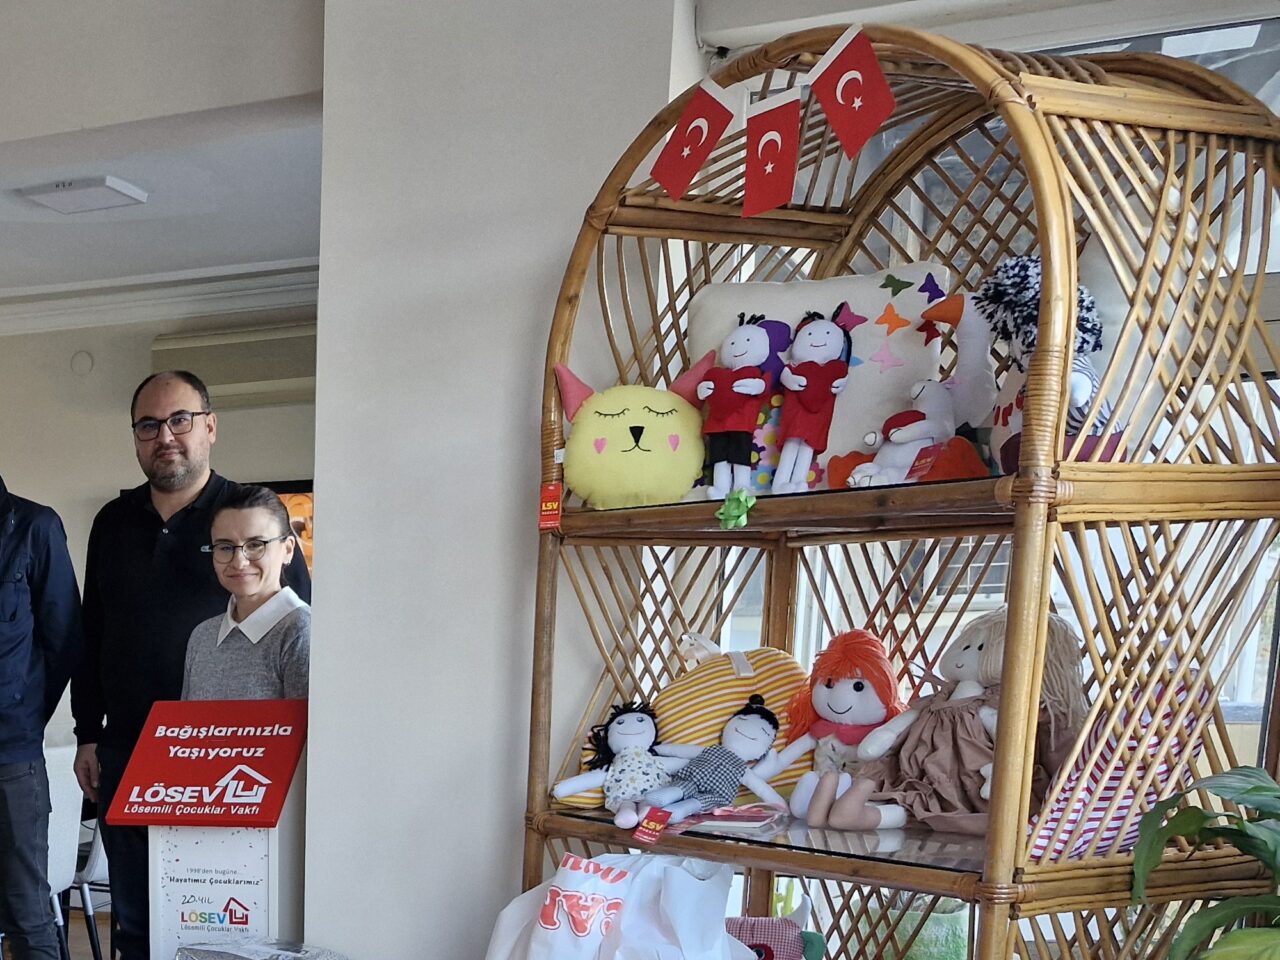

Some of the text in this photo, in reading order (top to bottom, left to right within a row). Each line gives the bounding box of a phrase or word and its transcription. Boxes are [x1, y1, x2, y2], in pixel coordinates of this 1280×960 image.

[154, 723, 292, 740] Bağışlarınızla
[168, 744, 265, 760] Yaşıyoruz
[129, 783, 224, 803] LÖSEV
[124, 804, 259, 815] Lösemili Çocuklar Vakfı
[180, 909, 227, 924] LÖSEV
